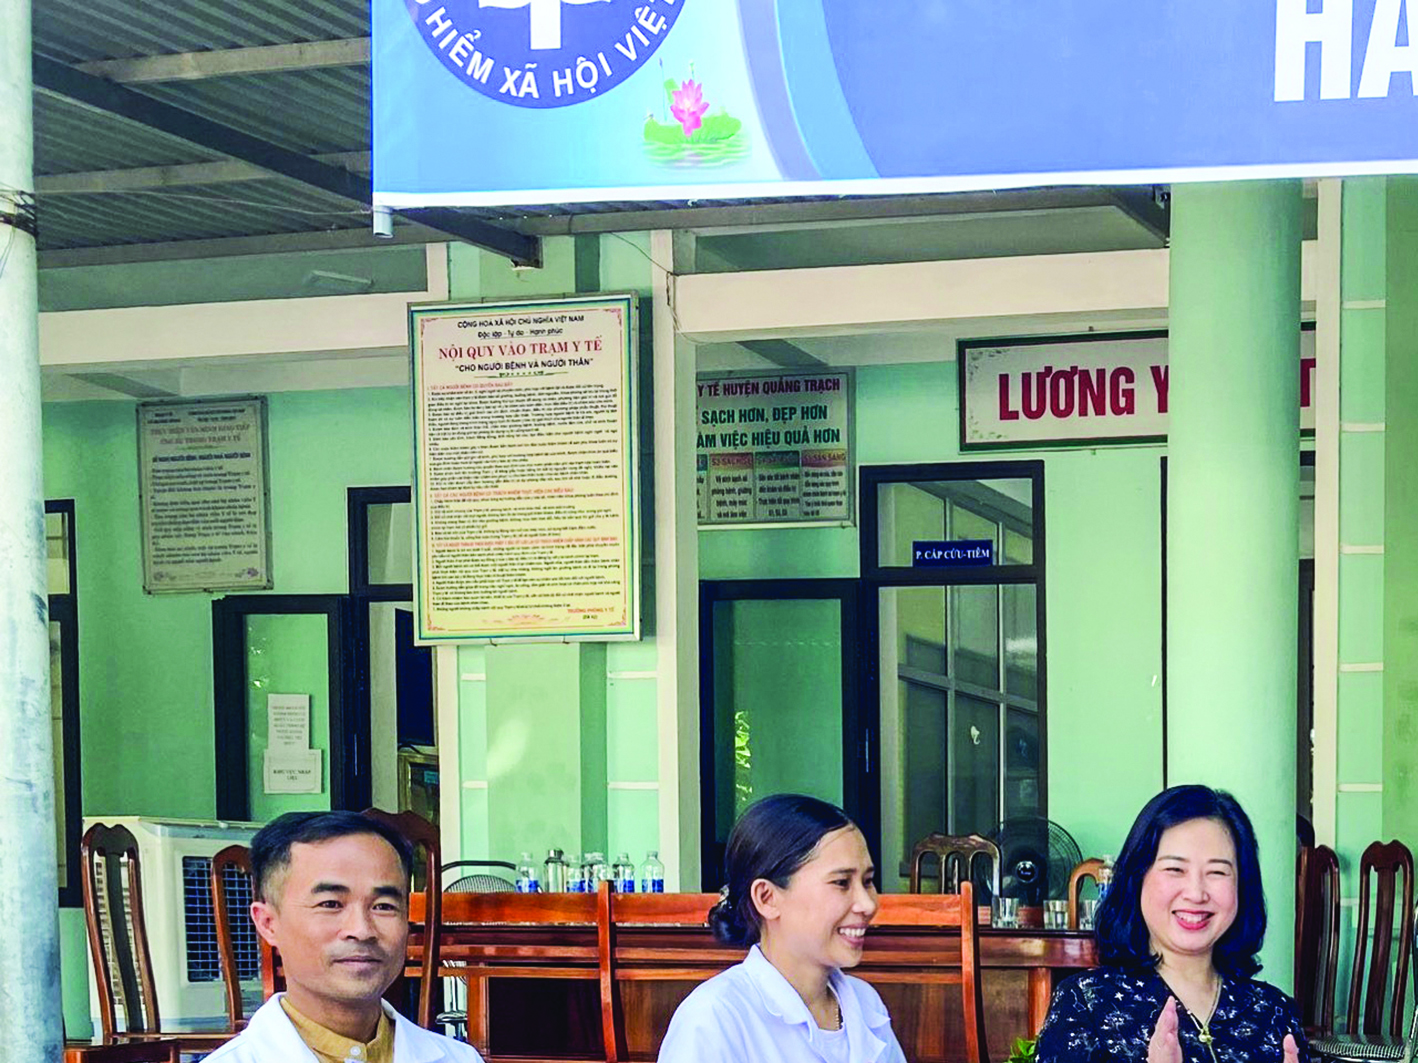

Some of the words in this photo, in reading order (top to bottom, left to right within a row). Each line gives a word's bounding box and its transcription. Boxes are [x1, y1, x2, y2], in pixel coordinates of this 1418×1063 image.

[425, 7, 494, 83] HIỂM
[499, 63, 539, 98] XÃ
[553, 52, 612, 97] HỘI
[614, 0, 675, 61] VIỆ
[439, 344, 463, 362] NỘI
[467, 345, 495, 360] QUY
[499, 341, 526, 356] VÀO
[530, 341, 568, 357] TRẠM
[573, 341, 581, 352] Y
[585, 335, 602, 351] TẾ
[478, 361, 503, 371] NGƯỜI
[505, 360, 527, 370] BỆNH
[529, 359, 539, 368] VÀ
[541, 358, 566, 368] NGƯỜI
[697, 385, 703, 397] Y
[708, 382, 720, 396] TẾ
[723, 381, 759, 398] HUYỆN
[763, 377, 800, 394] QUẢNG
[804, 378, 840, 394] TRẠCH
[999, 365, 1135, 421] LƯƠNG
[1150, 365, 1169, 414] Y
[702, 410, 734, 427] SẠCH
[739, 408, 768, 423] HƠN,
[773, 407, 797, 424] ĐẸP
[801, 405, 827, 420] HƠN
[697, 432, 716, 448] ÀM
[721, 430, 748, 450] VIỆC
[752, 429, 780, 449] HIỆU
[785, 425, 810, 446] QUẢ
[814, 428, 840, 443] HƠN
[916, 550, 923, 560] P.
[925, 548, 943, 559] CẤP
[944, 546, 990, 559] CỨU-TIÊM
